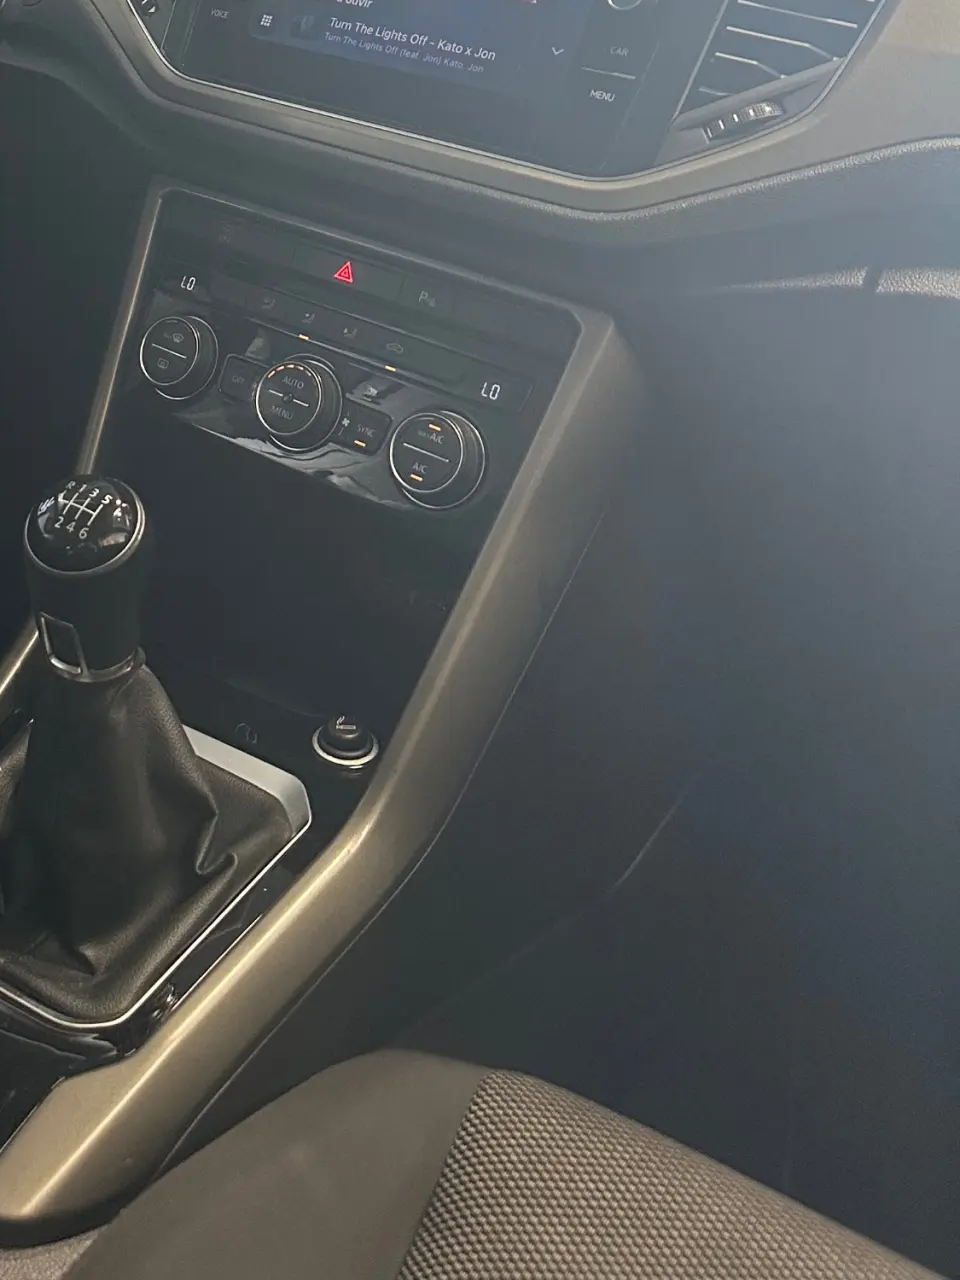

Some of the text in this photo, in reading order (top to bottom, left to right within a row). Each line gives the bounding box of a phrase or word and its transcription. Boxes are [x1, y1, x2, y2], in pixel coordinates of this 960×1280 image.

[210, 7, 230, 19] VOICE
[329, 17, 352, 31] Turn
[355, 22, 374, 36] The
[375, 26, 407, 43] Lights
[409, 33, 427, 47] Off
[437, 38, 462, 55] Kato
[464, 46, 472, 56] x
[473, 45, 496, 61] Jon
[324, 31, 342, 43] Turn
[342, 35, 357, 47] The
[358, 38, 383, 53] Lights
[385, 42, 400, 55] Off
[467, 61, 484, 74] Jon
[609, 46, 630, 58] CAR
[589, 89, 616, 102] MENU
[180, 275, 197, 291] LO
[282, 375, 305, 389] AUTO
[480, 380, 501, 401] LO
[270, 404, 294, 420] MENU
[356, 423, 377, 438] SYNC
[429, 432, 444, 445] A/C
[412, 462, 428, 475] A/C
[89, 488, 99, 497] 3
[101, 495, 113, 504] 5
[54, 516, 89, 539] 2 4 6
